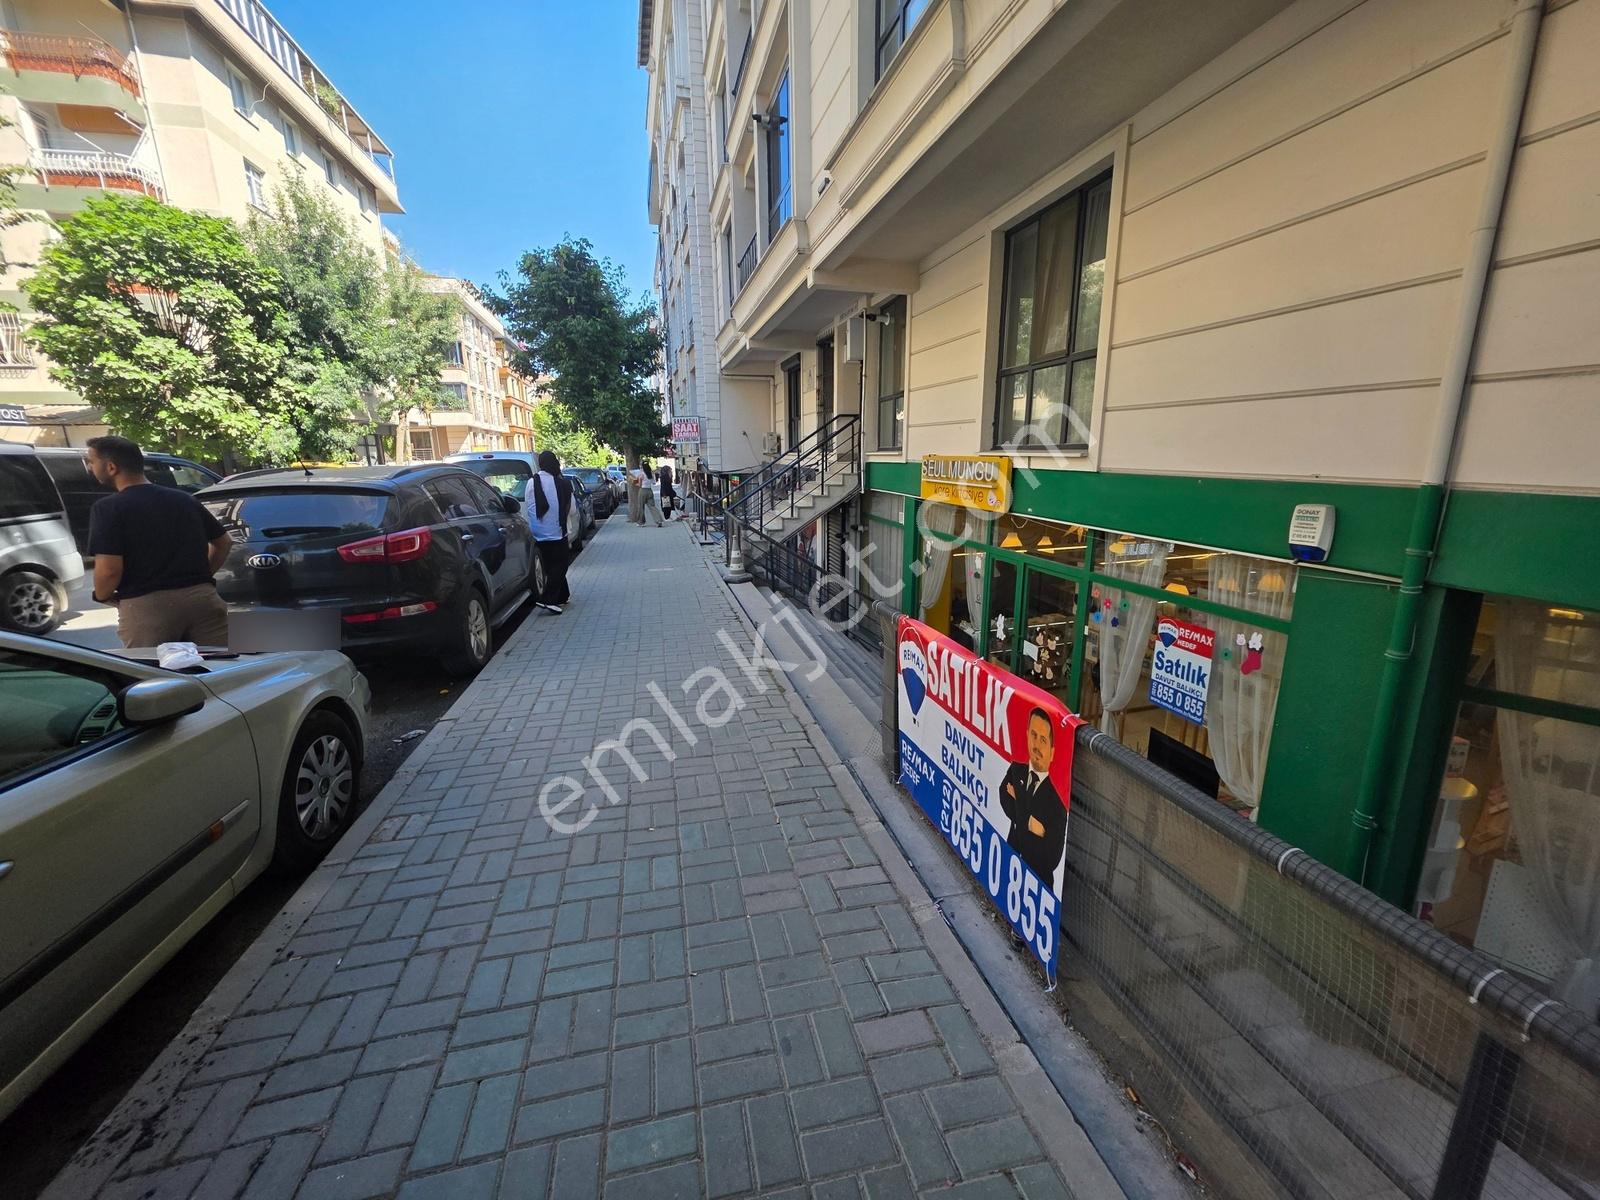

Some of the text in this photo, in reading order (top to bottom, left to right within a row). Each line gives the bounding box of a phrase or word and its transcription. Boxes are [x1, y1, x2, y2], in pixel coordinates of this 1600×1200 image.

[674, 423, 698, 432] SAAT
[922, 459, 994, 481] SEUL MUNGU
[253, 557, 275, 566] KIA
[1177, 640, 1197, 650] HEDEF
[1180, 627, 1214, 647] RE/MAX
[1155, 651, 1208, 689] Satılık
[1155, 673, 1175, 687] DAVUT
[927, 640, 1015, 755] SATILIK
[1157, 684, 1174, 703] 855
[1176, 693, 1182, 707] 0
[1184, 696, 1204, 717] 855
[945, 720, 985, 771] DAVUT
[902, 740, 935, 786] RE/MAX
[902, 758, 921, 786] HEDEF
[942, 744, 988, 808] BALIKÇI
[941, 779, 1055, 963] (212) 855 0 855
